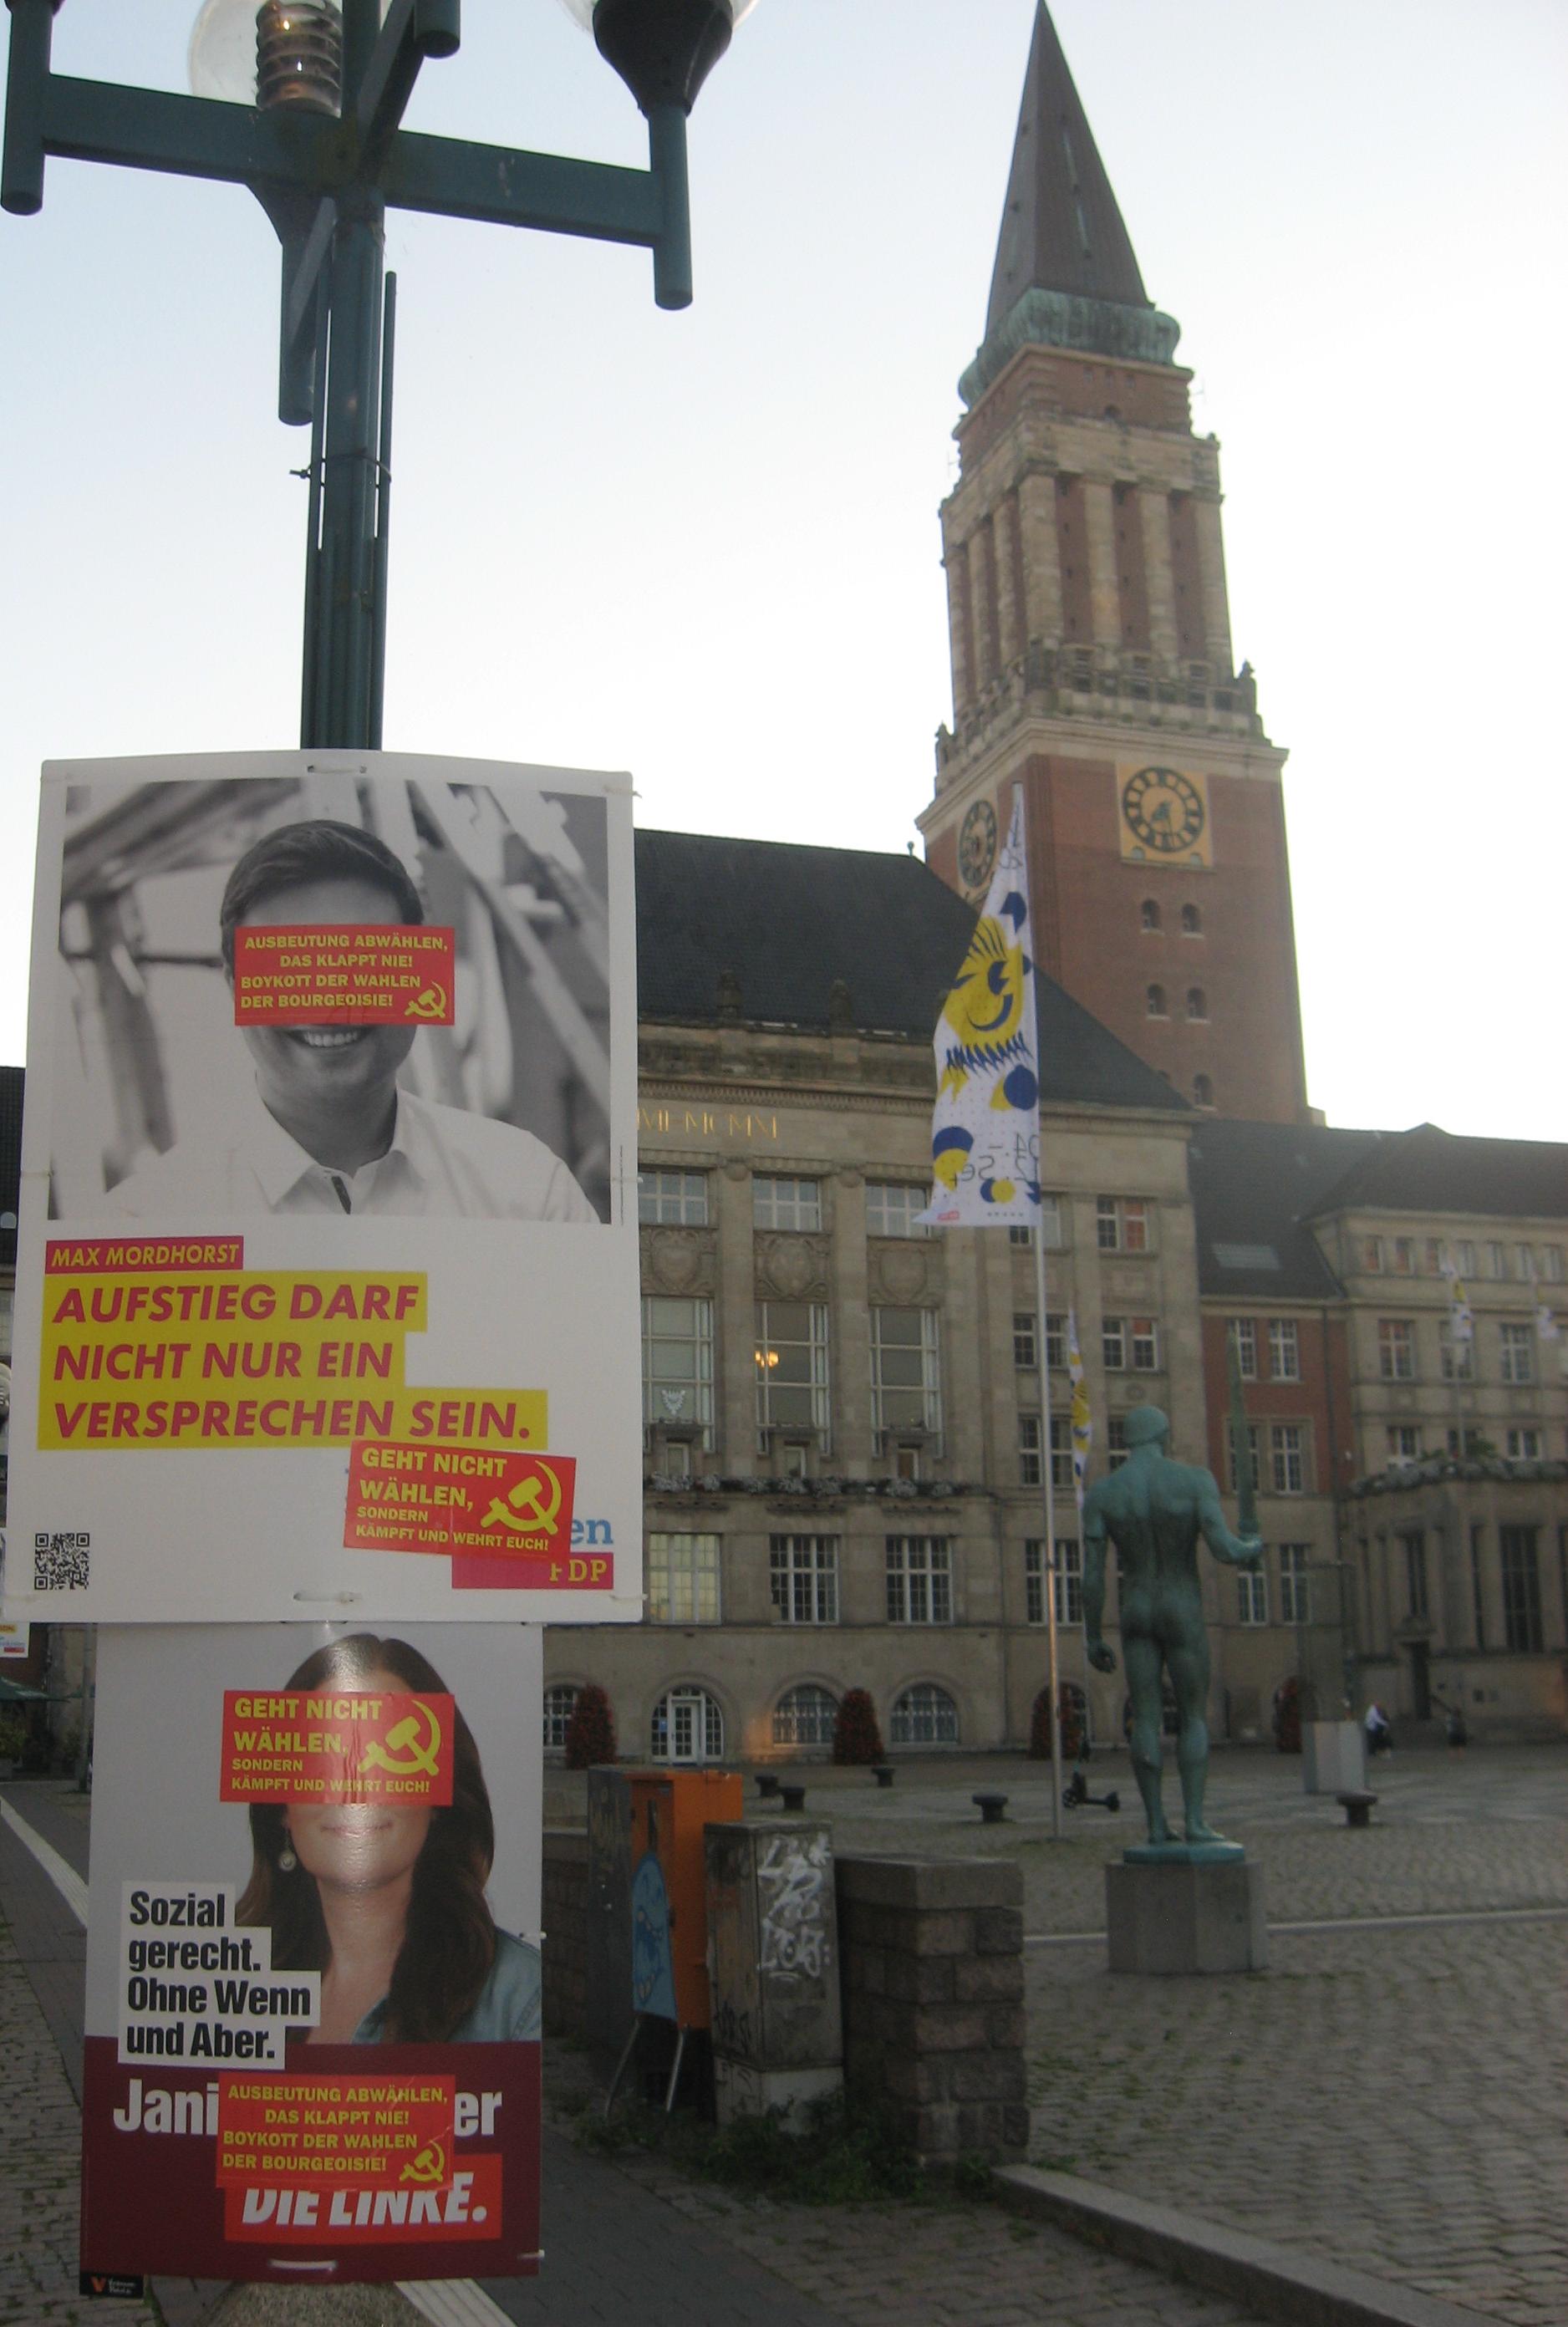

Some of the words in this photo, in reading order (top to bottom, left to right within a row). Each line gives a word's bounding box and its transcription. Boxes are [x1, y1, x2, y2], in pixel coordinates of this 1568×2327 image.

[245, 935, 350, 949] AUSBEUTUNG
[354, 934, 448, 952] ABWÄHLEN,
[280, 955, 312, 967] DAS
[317, 955, 377, 967] KLAPPT
[382, 955, 413, 967] NIE!
[241, 975, 311, 989] BOYKOTT
[316, 975, 348, 987] DER
[354, 975, 420, 987] WAHLEN
[241, 995, 273, 1008] DER
[278, 995, 393, 1007] BOURGEOISIE!
[52, 1248, 100, 1267] MAX
[105, 1244, 239, 1265] MORDHORST
[52, 1284, 277, 1323] AUFSTIEG
[288, 1284, 420, 1319] DARF
[53, 1343, 191, 1381] NICHT
[201, 1342, 302, 1379] NUR
[318, 1342, 393, 1377] EIN
[53, 1400, 395, 1438] VERSPRECHEN
[408, 1401, 530, 1438] SEIN.
[362, 1448, 428, 1472] GEHT
[433, 1455, 507, 1477] NICHT
[359, 1477, 473, 1511] WÄHLEN,
[357, 1507, 428, 1523] SONDERN
[356, 1524, 416, 1540] KÄMPFT
[419, 1530, 448, 1542] UND
[452, 1532, 502, 1546] WEHRT
[507, 1537, 548, 1550] EUCH!
[234, 1698, 299, 1719] GEHT
[306, 1699, 383, 1719] NICHT
[232, 1759, 303, 1771] SONDERN
[232, 1776, 290, 1790] KÄMPFT
[294, 1780, 324, 1791] UND
[330, 1780, 382, 1792] WEHRT
[385, 1780, 430, 1793] EUCH!
[130, 1891, 225, 1927] Sozial
[129, 1937, 261, 1972] gerecht.
[128, 1977, 207, 2013] Ohne
[214, 1979, 310, 2015] Wenn
[127, 2022, 184, 2055] und
[190, 2022, 275, 2058] Aber.
[228, 2085, 341, 2102] AUSBEUTUNG
[346, 2085, 448, 2104] ABWÄHLEN,
[265, 2109, 298, 2124] DAS
[304, 2111, 369, 2125] KLAPPT
[375, 2111, 409, 2125] NIE!
[223, 2131, 298, 2146] BOYKOTT
[303, 2134, 338, 2148] DER
[344, 2134, 417, 2148] WAHLEN
[222, 2154, 257, 2168] DER
[262, 2156, 387, 2172] BOURGEOISIE!
